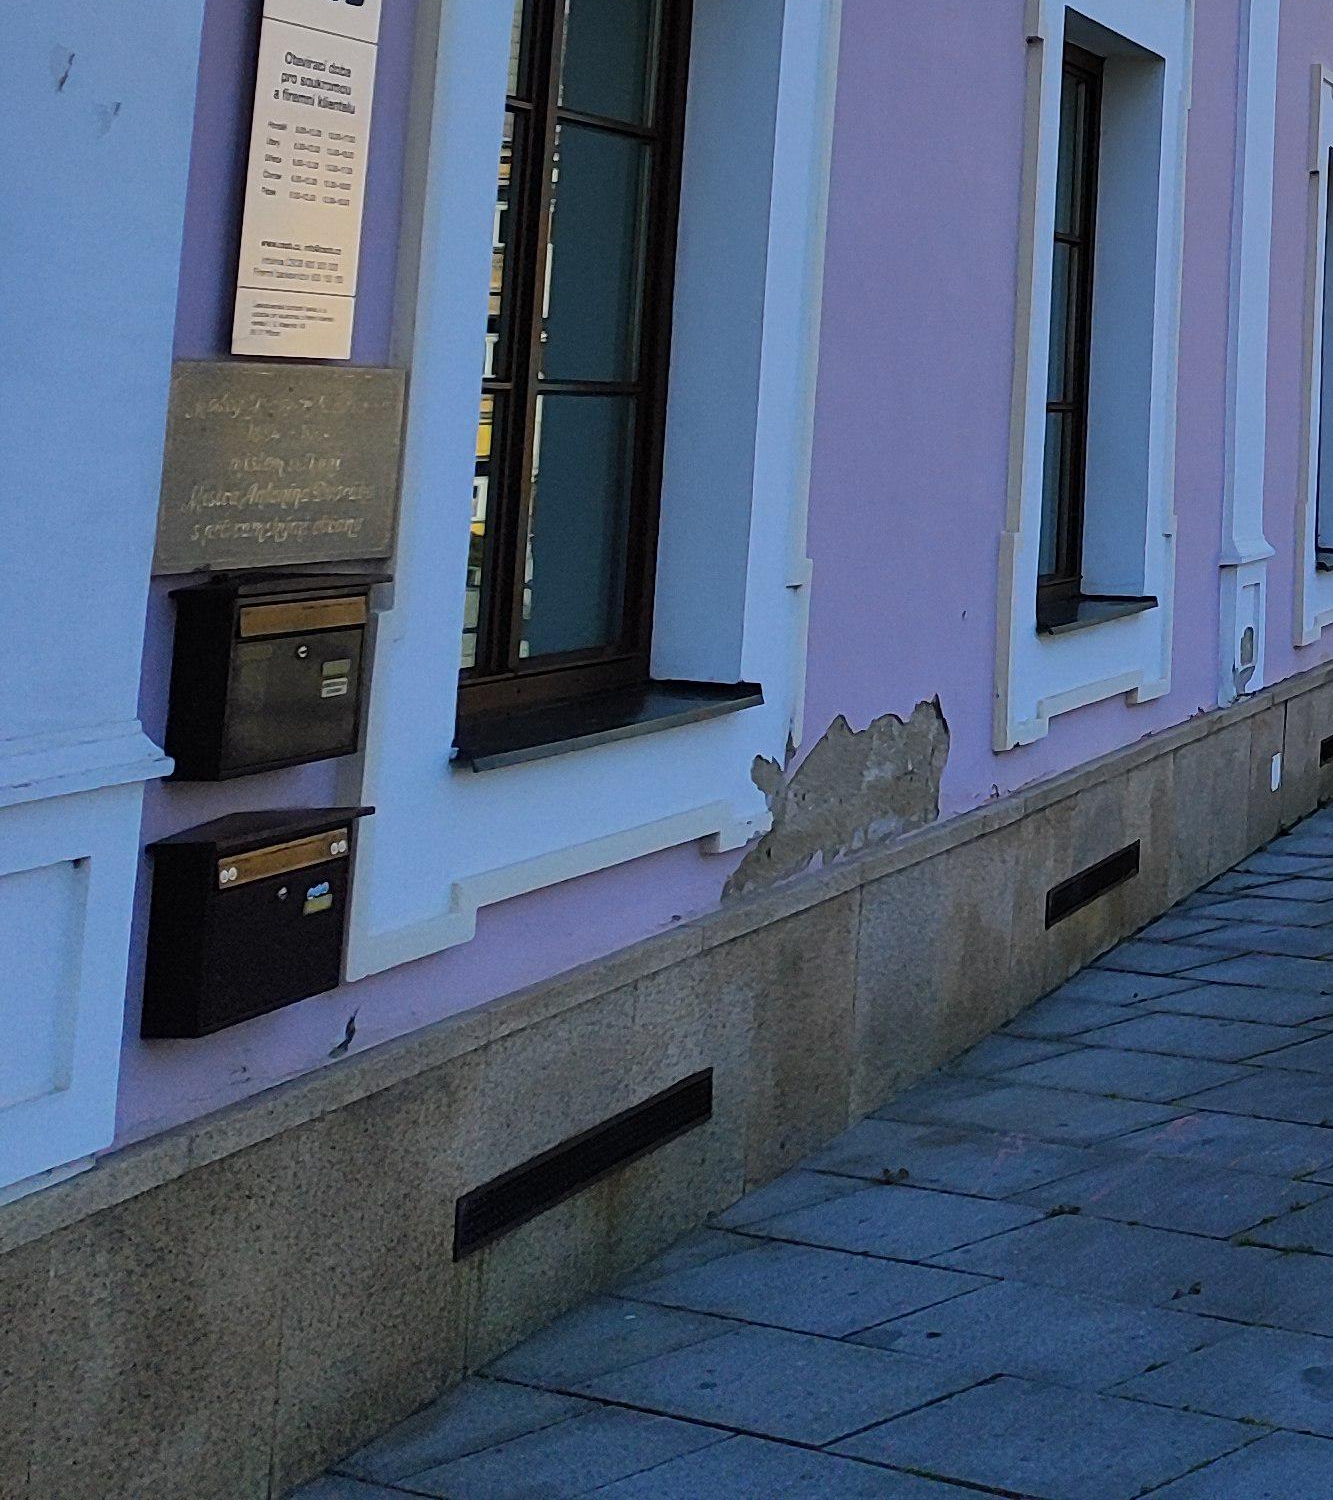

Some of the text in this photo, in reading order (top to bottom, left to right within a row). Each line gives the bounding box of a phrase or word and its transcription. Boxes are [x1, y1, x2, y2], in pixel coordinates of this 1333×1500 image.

[281, 72, 351, 96] pro soukromou
[273, 89, 280, 100] a
